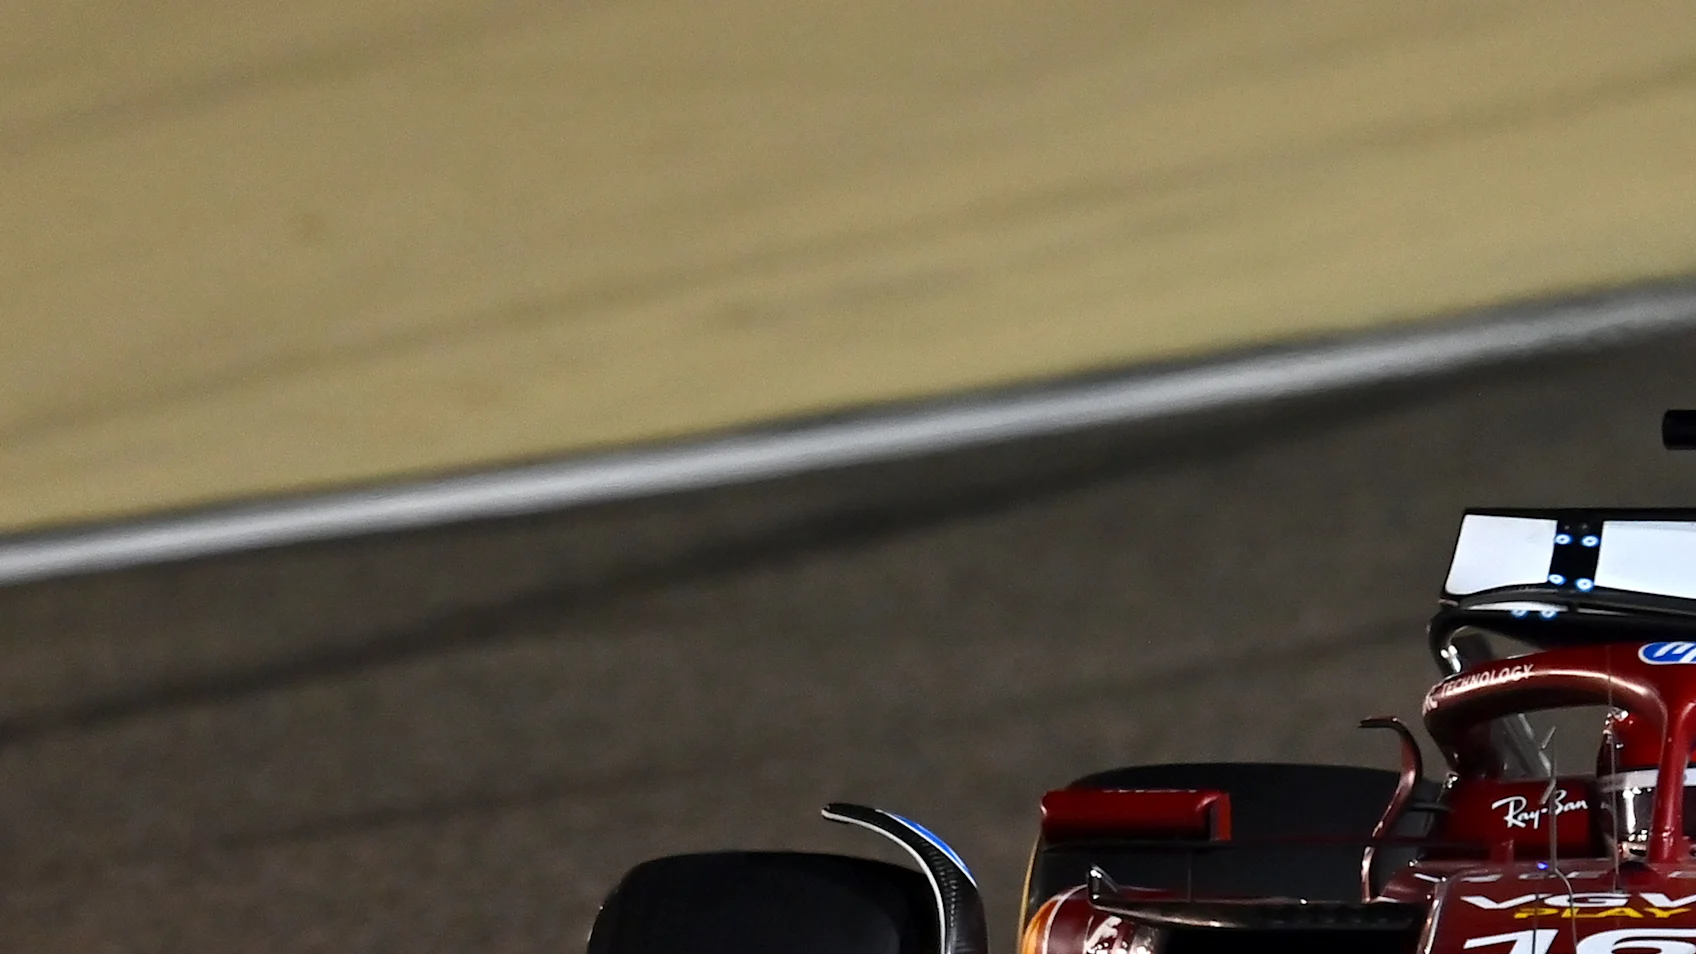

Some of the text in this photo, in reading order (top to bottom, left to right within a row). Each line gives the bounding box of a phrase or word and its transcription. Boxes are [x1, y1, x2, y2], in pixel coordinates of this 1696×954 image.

[1441, 663, 1535, 698] TECHNOLOGY
[1491, 789, 1588, 829] Ray-Ban
[1514, 908, 1691, 919] PLAY
